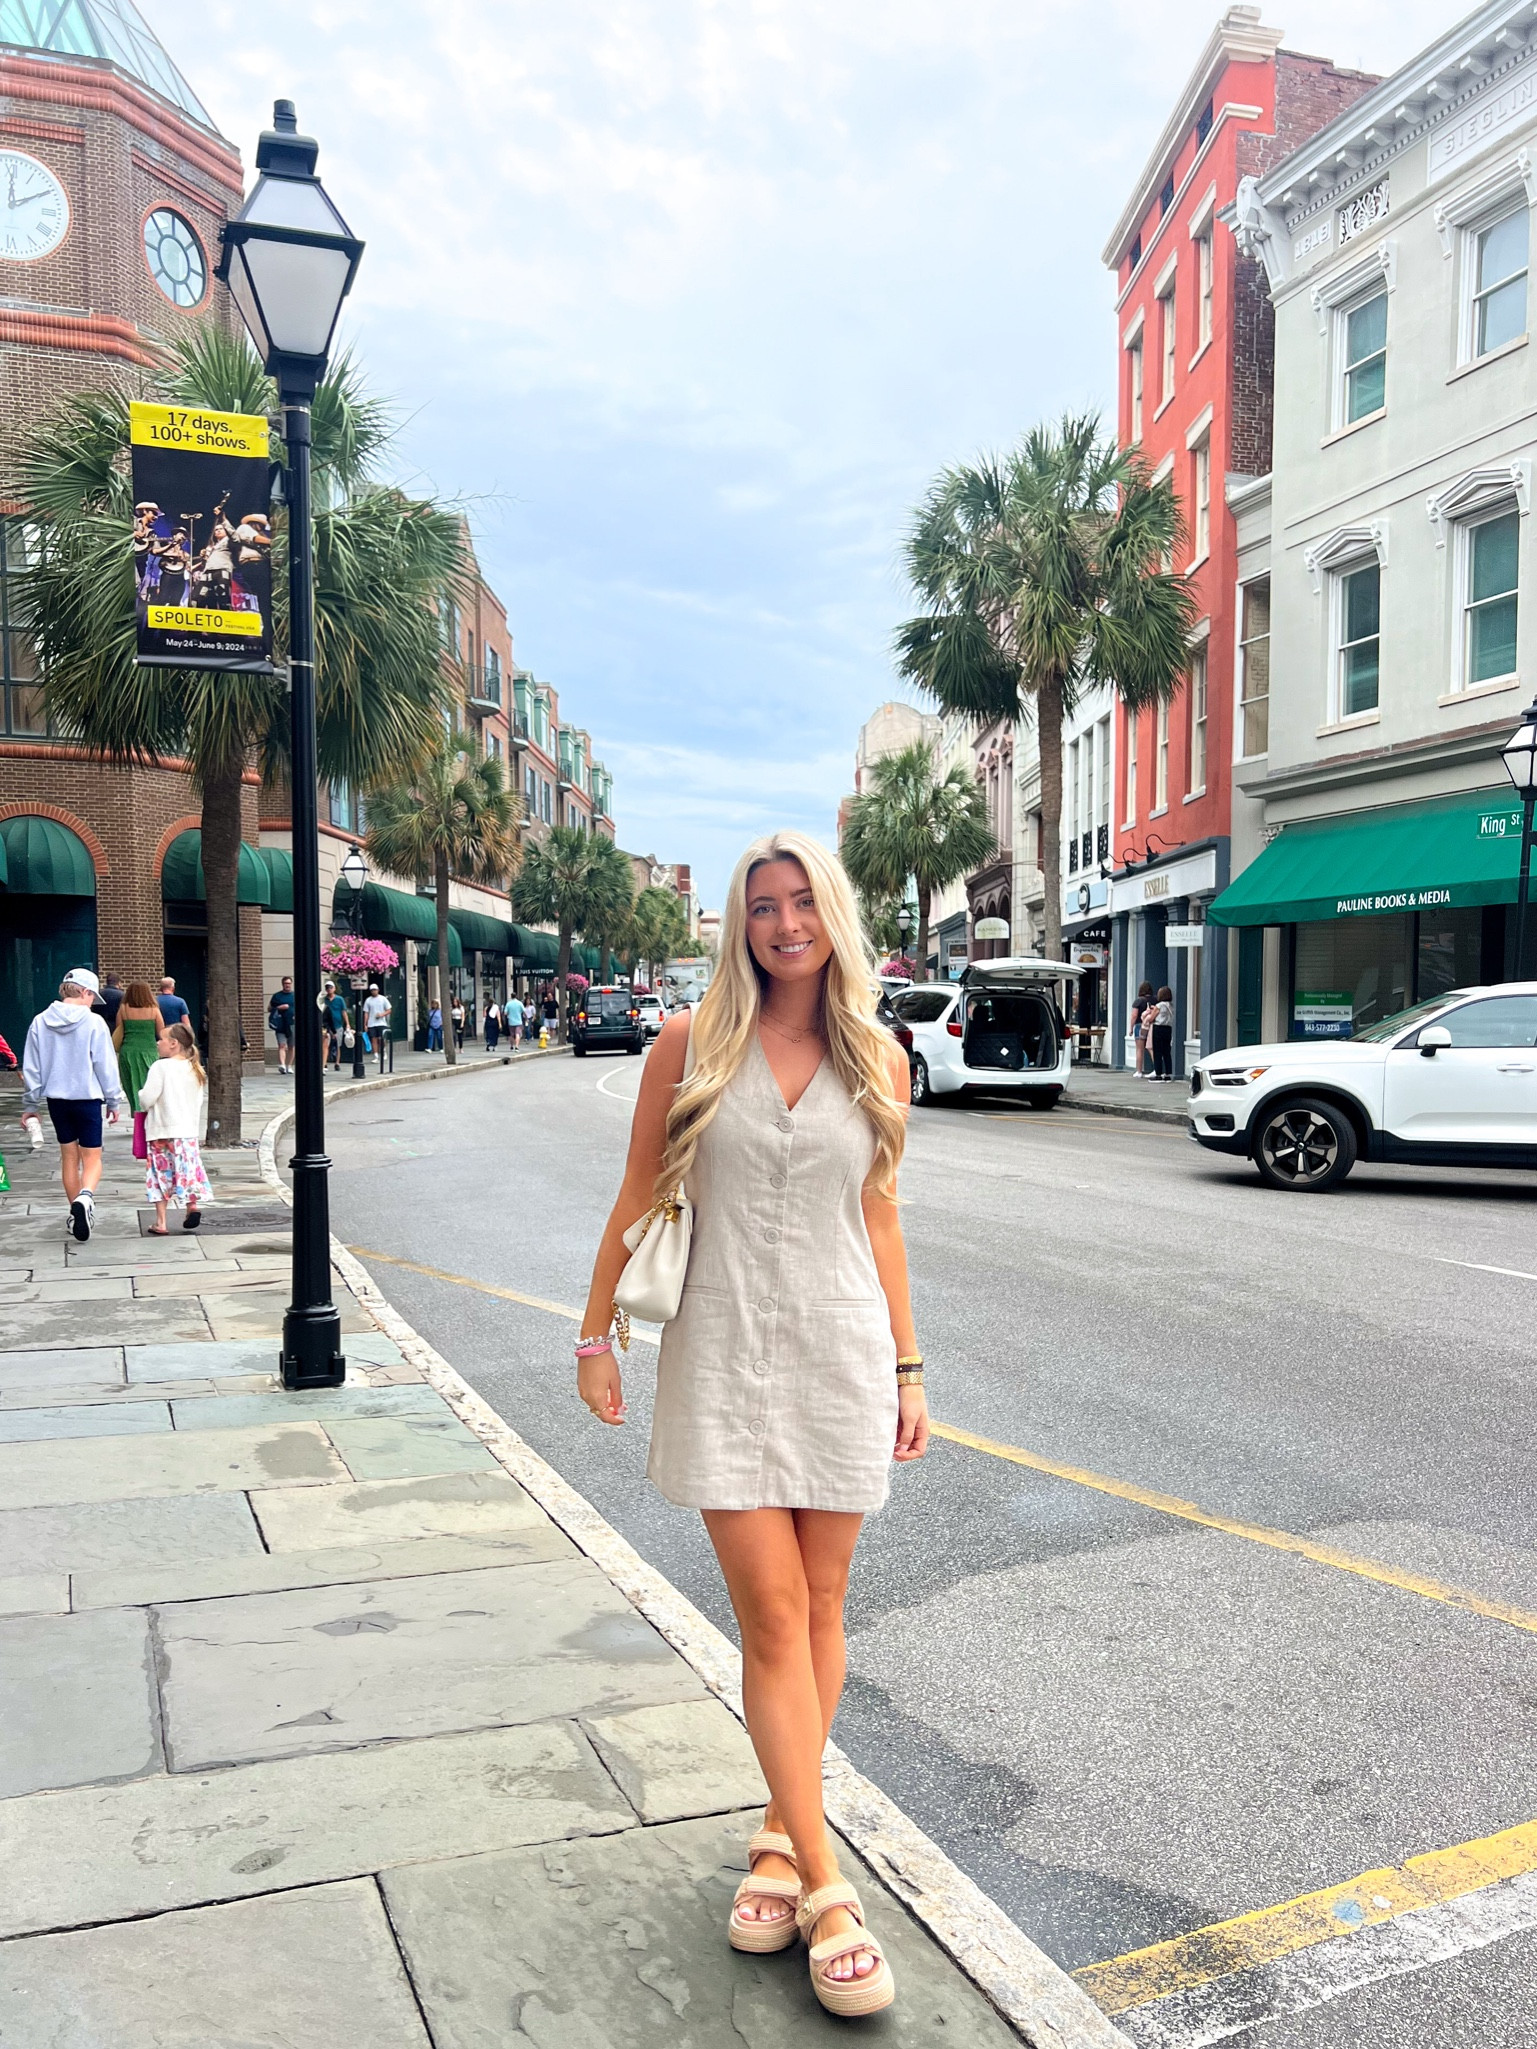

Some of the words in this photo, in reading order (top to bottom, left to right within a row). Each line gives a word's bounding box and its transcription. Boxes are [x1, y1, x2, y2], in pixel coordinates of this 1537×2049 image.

[168, 412, 188, 427] 17
[192, 415, 233, 434] days.
[150, 425, 193, 442] 100+
[196, 431, 251, 451] shows.
[155, 611, 223, 628] SPOLETO
[166, 638, 182, 648] May
[225, 643, 245, 651] 2024
[1481, 816, 1506, 836] King
[1511, 813, 1520, 826] St
[1337, 897, 1373, 913] PAULINE
[1374, 893, 1407, 909] BOOKS
[1408, 893, 1416, 905] &
[1418, 889, 1451, 904] MEDIA
[1083, 930, 1106, 938] CAFE
